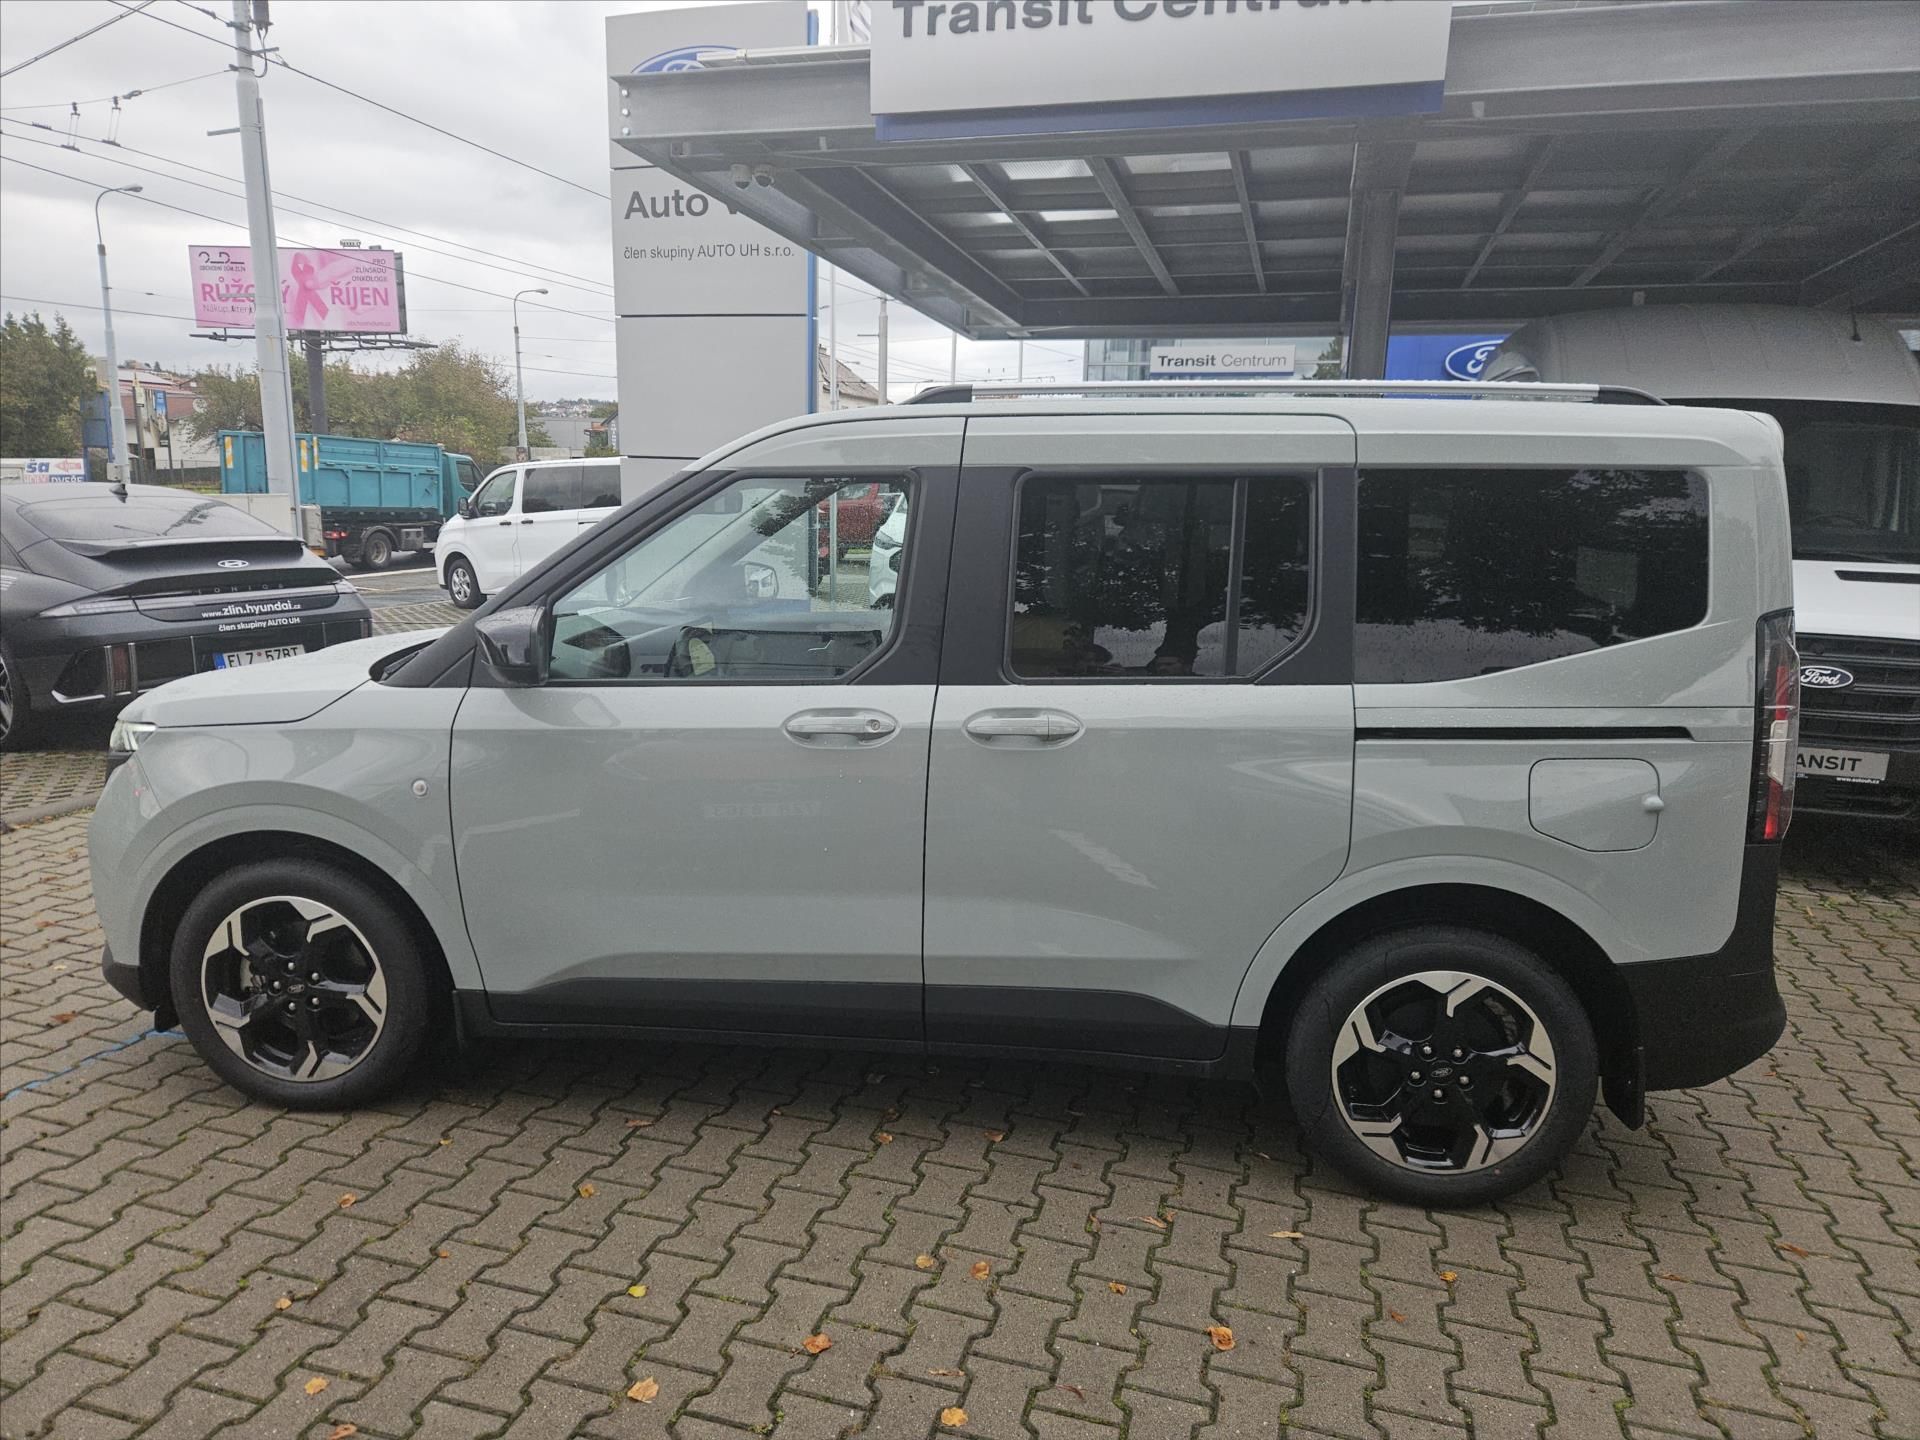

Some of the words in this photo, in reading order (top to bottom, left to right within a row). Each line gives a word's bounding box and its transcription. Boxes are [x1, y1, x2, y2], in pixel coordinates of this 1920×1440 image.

[893, 0, 1093, 38] Transit
[624, 189, 709, 219] Auto
[624, 246, 647, 259] člen
[650, 246, 695, 261] skupiny
[697, 243, 736, 257] AUTO
[739, 243, 760, 257] UH
[763, 245, 795, 257] s.r.o.
[330, 280, 389, 311] ŘÍJEN
[1158, 355, 1217, 367] Transit
[1221, 354, 1287, 367] Centrum
[201, 600, 301, 618] www.zlin.hyundai.cz
[218, 624, 236, 632] člen
[237, 621, 267, 631] skupiny
[267, 617, 288, 627] AUTO
[1800, 668, 1841, 685] Ford
